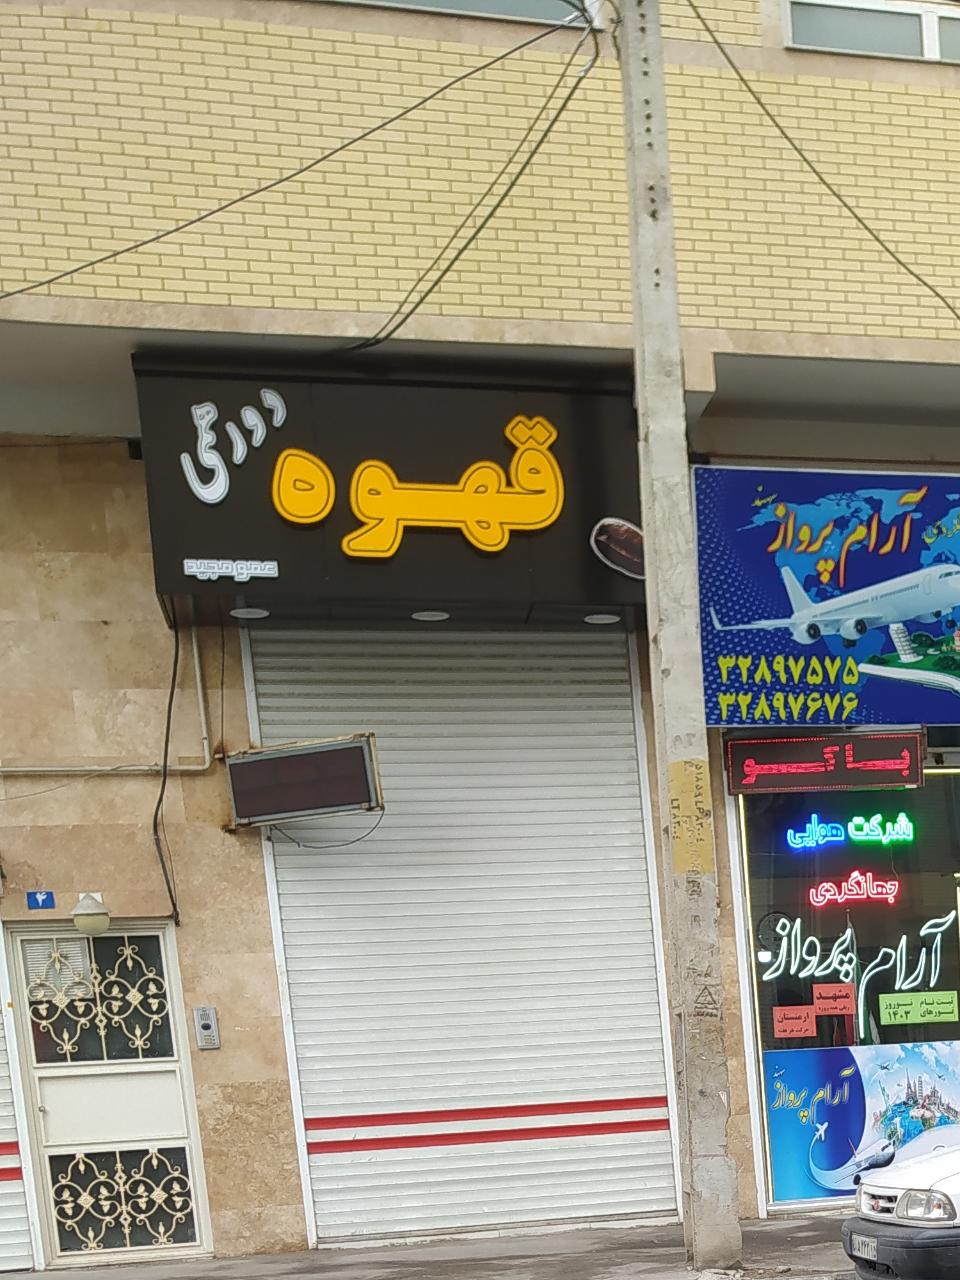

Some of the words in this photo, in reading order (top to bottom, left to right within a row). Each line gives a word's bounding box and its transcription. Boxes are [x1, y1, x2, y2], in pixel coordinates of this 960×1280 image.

[272, 414, 565, 559] قهوه
[766, 502, 836, 584] پرواز
[838, 485, 929, 588] آرام
[717, 654, 860, 685] ۳۲۸۹۷۵۷۵
[717, 691, 860, 721] ۳۲۸۹۷۶۷۶
[787, 814, 845, 848] هوایی
[847, 812, 914, 845] شرکت
[35, 891, 48, 908] ۴
[809, 870, 899, 907] جهانگردی
[762, 917, 857, 983] پرواز
[858, 910, 957, 1039] آرام
[815, 988, 851, 1001] مشهد
[884, 999, 914, 1010] نوروز
[919, 998, 934, 1006] نام
[936, 997, 954, 1006] ثبت
[776, 1011, 810, 1024] ارمنستان
[887, 1010, 912, 1021] ۱۴۰۳
[919, 1007, 955, 1018] تورهای
[771, 1081, 810, 1125] پرواز
[810, 1065, 855, 1125] آرام
